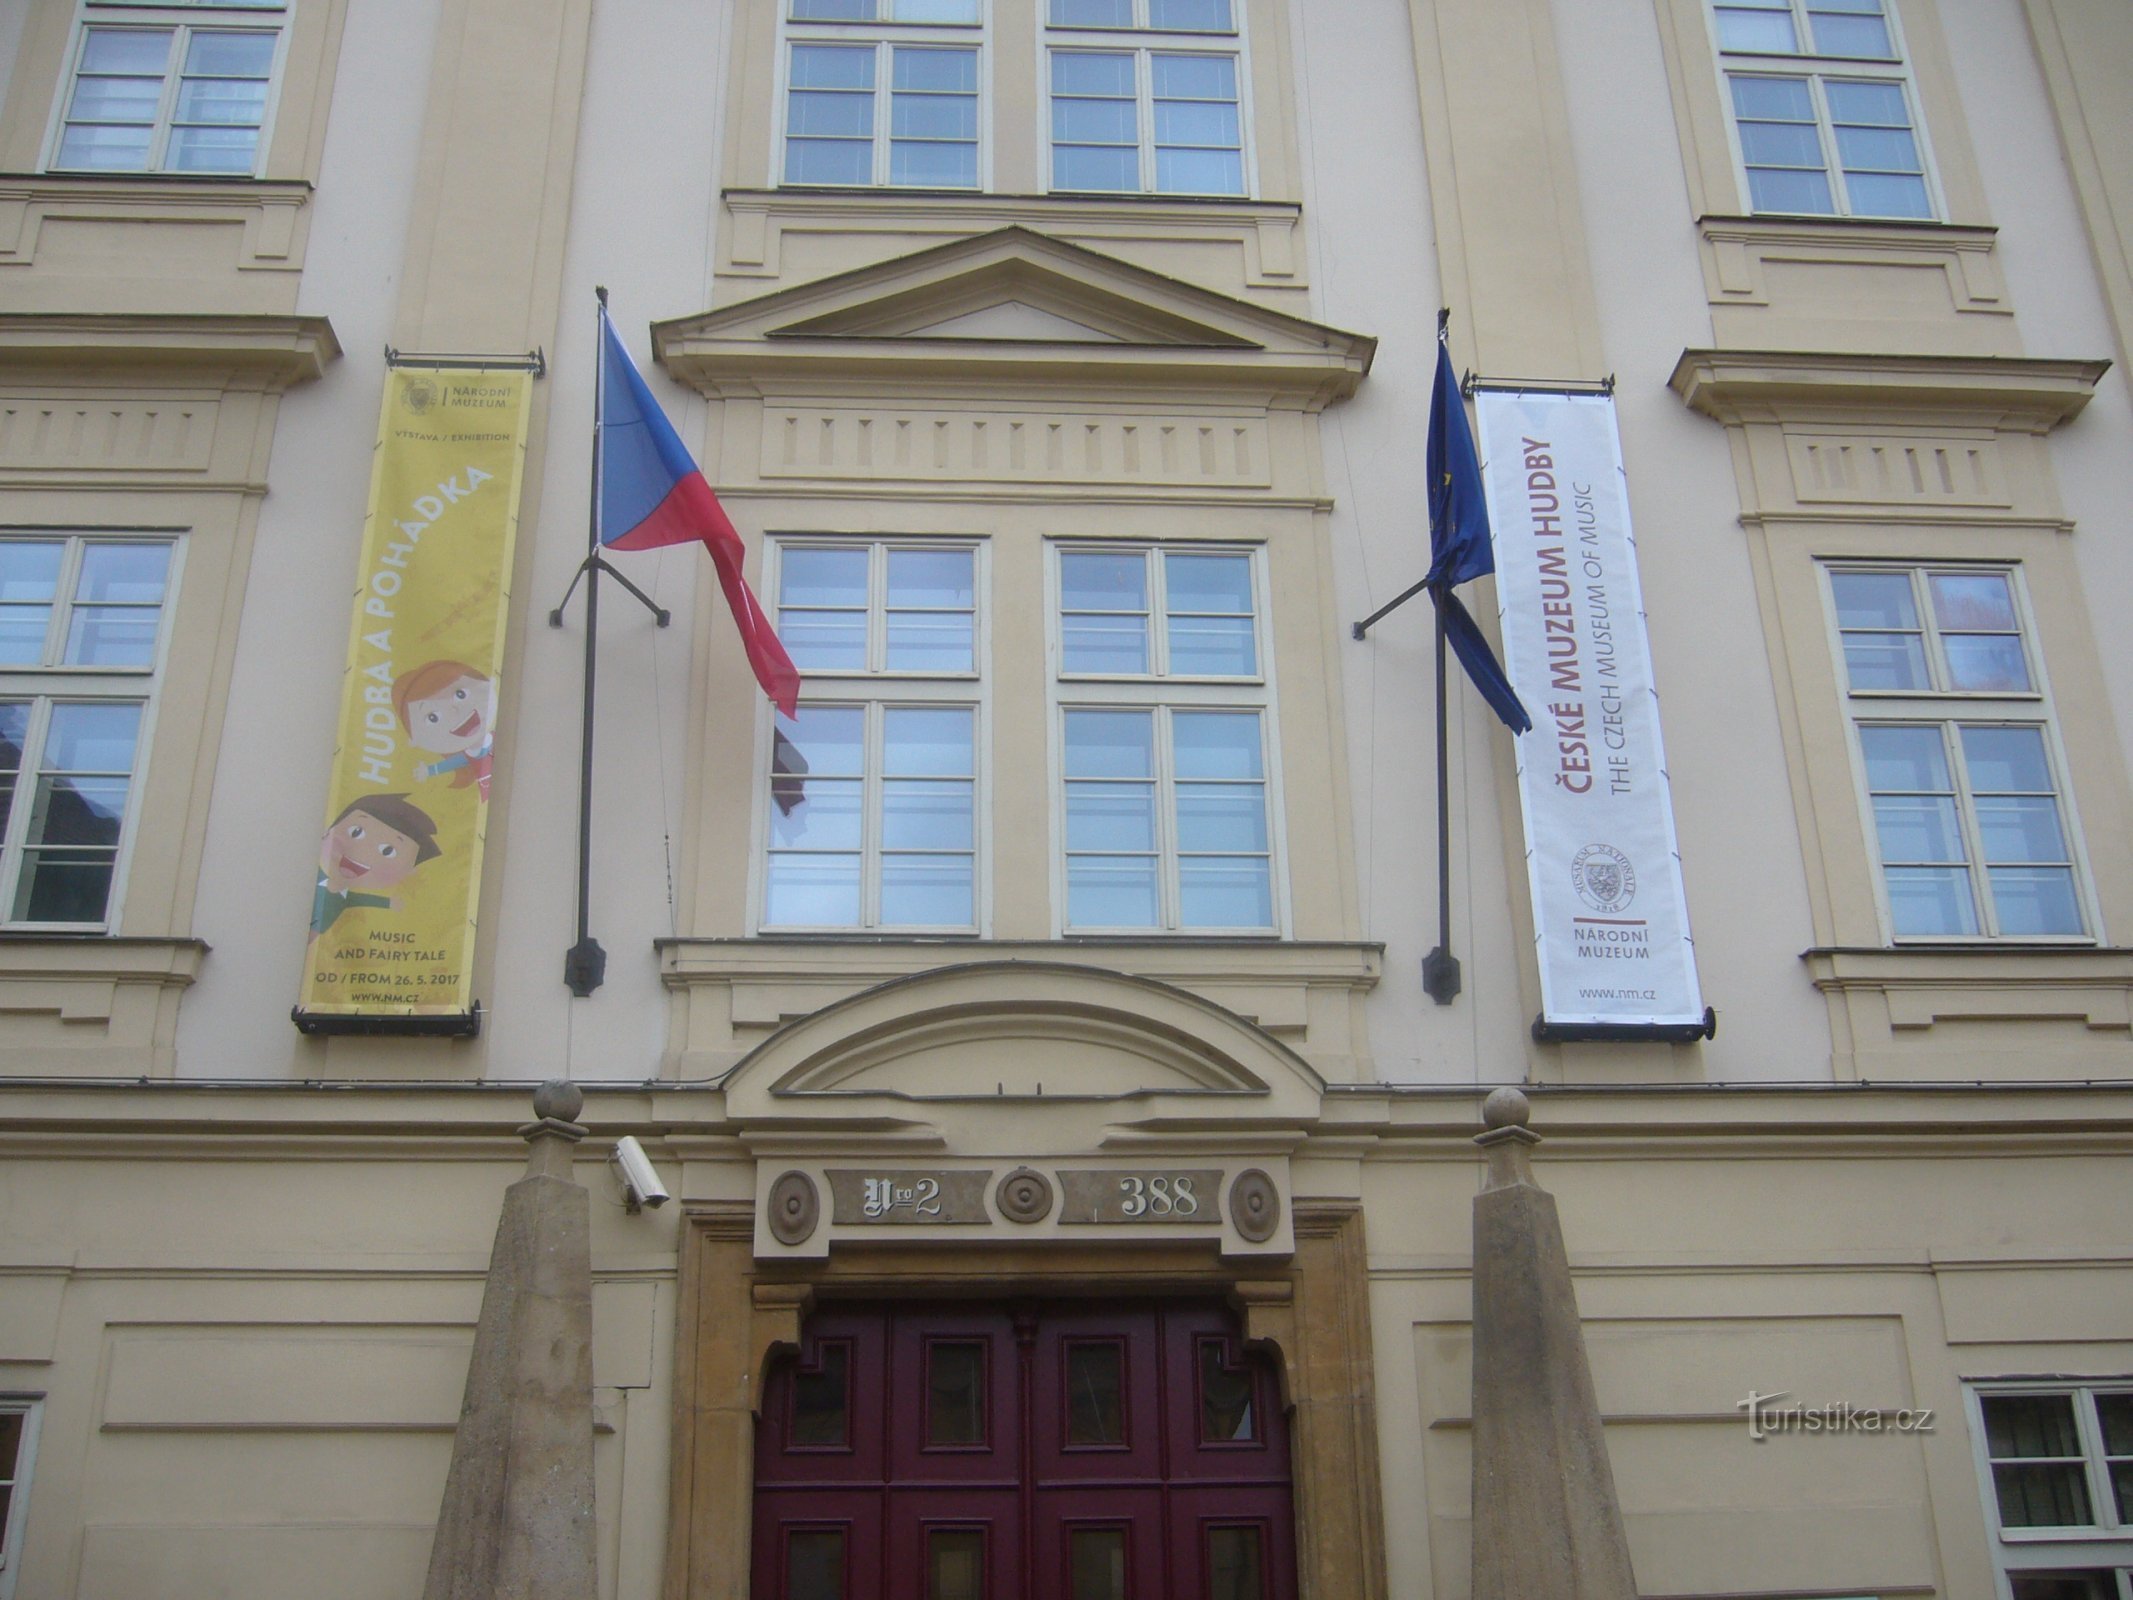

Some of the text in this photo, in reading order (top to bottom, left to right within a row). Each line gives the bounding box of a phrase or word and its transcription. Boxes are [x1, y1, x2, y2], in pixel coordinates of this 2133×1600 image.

[452, 386, 511, 397] NÁRODNÍ
[451, 399, 506, 408] MUZEUM
[451, 433, 510, 442] EXHIBITION
[1521, 437, 1593, 793] ČESKÉ MUZEUM HUDBY
[359, 466, 494, 785] HUDBA A POHÁDKA
[1573, 482, 1631, 796] THE CZECH MUSEUM OF MUSIC
[369, 930, 416, 943] MUSIC
[1574, 928, 1648, 942] NÁRODNÍ
[334, 949, 445, 961] AND FAIRY TALE
[1578, 946, 1649, 959] MUZEUM
[316, 973, 338, 983] OD
[351, 973, 391, 984] FROM
[394, 975, 413, 985] 26.
[417, 975, 427, 985] 5.
[431, 974, 460, 985] 2017
[352, 993, 420, 1003] WWW.NM.CZ
[1579, 989, 1656, 1000] www.nm.cz
[916, 1178, 941, 1215] 2
[1120, 1177, 1198, 1216] 388
